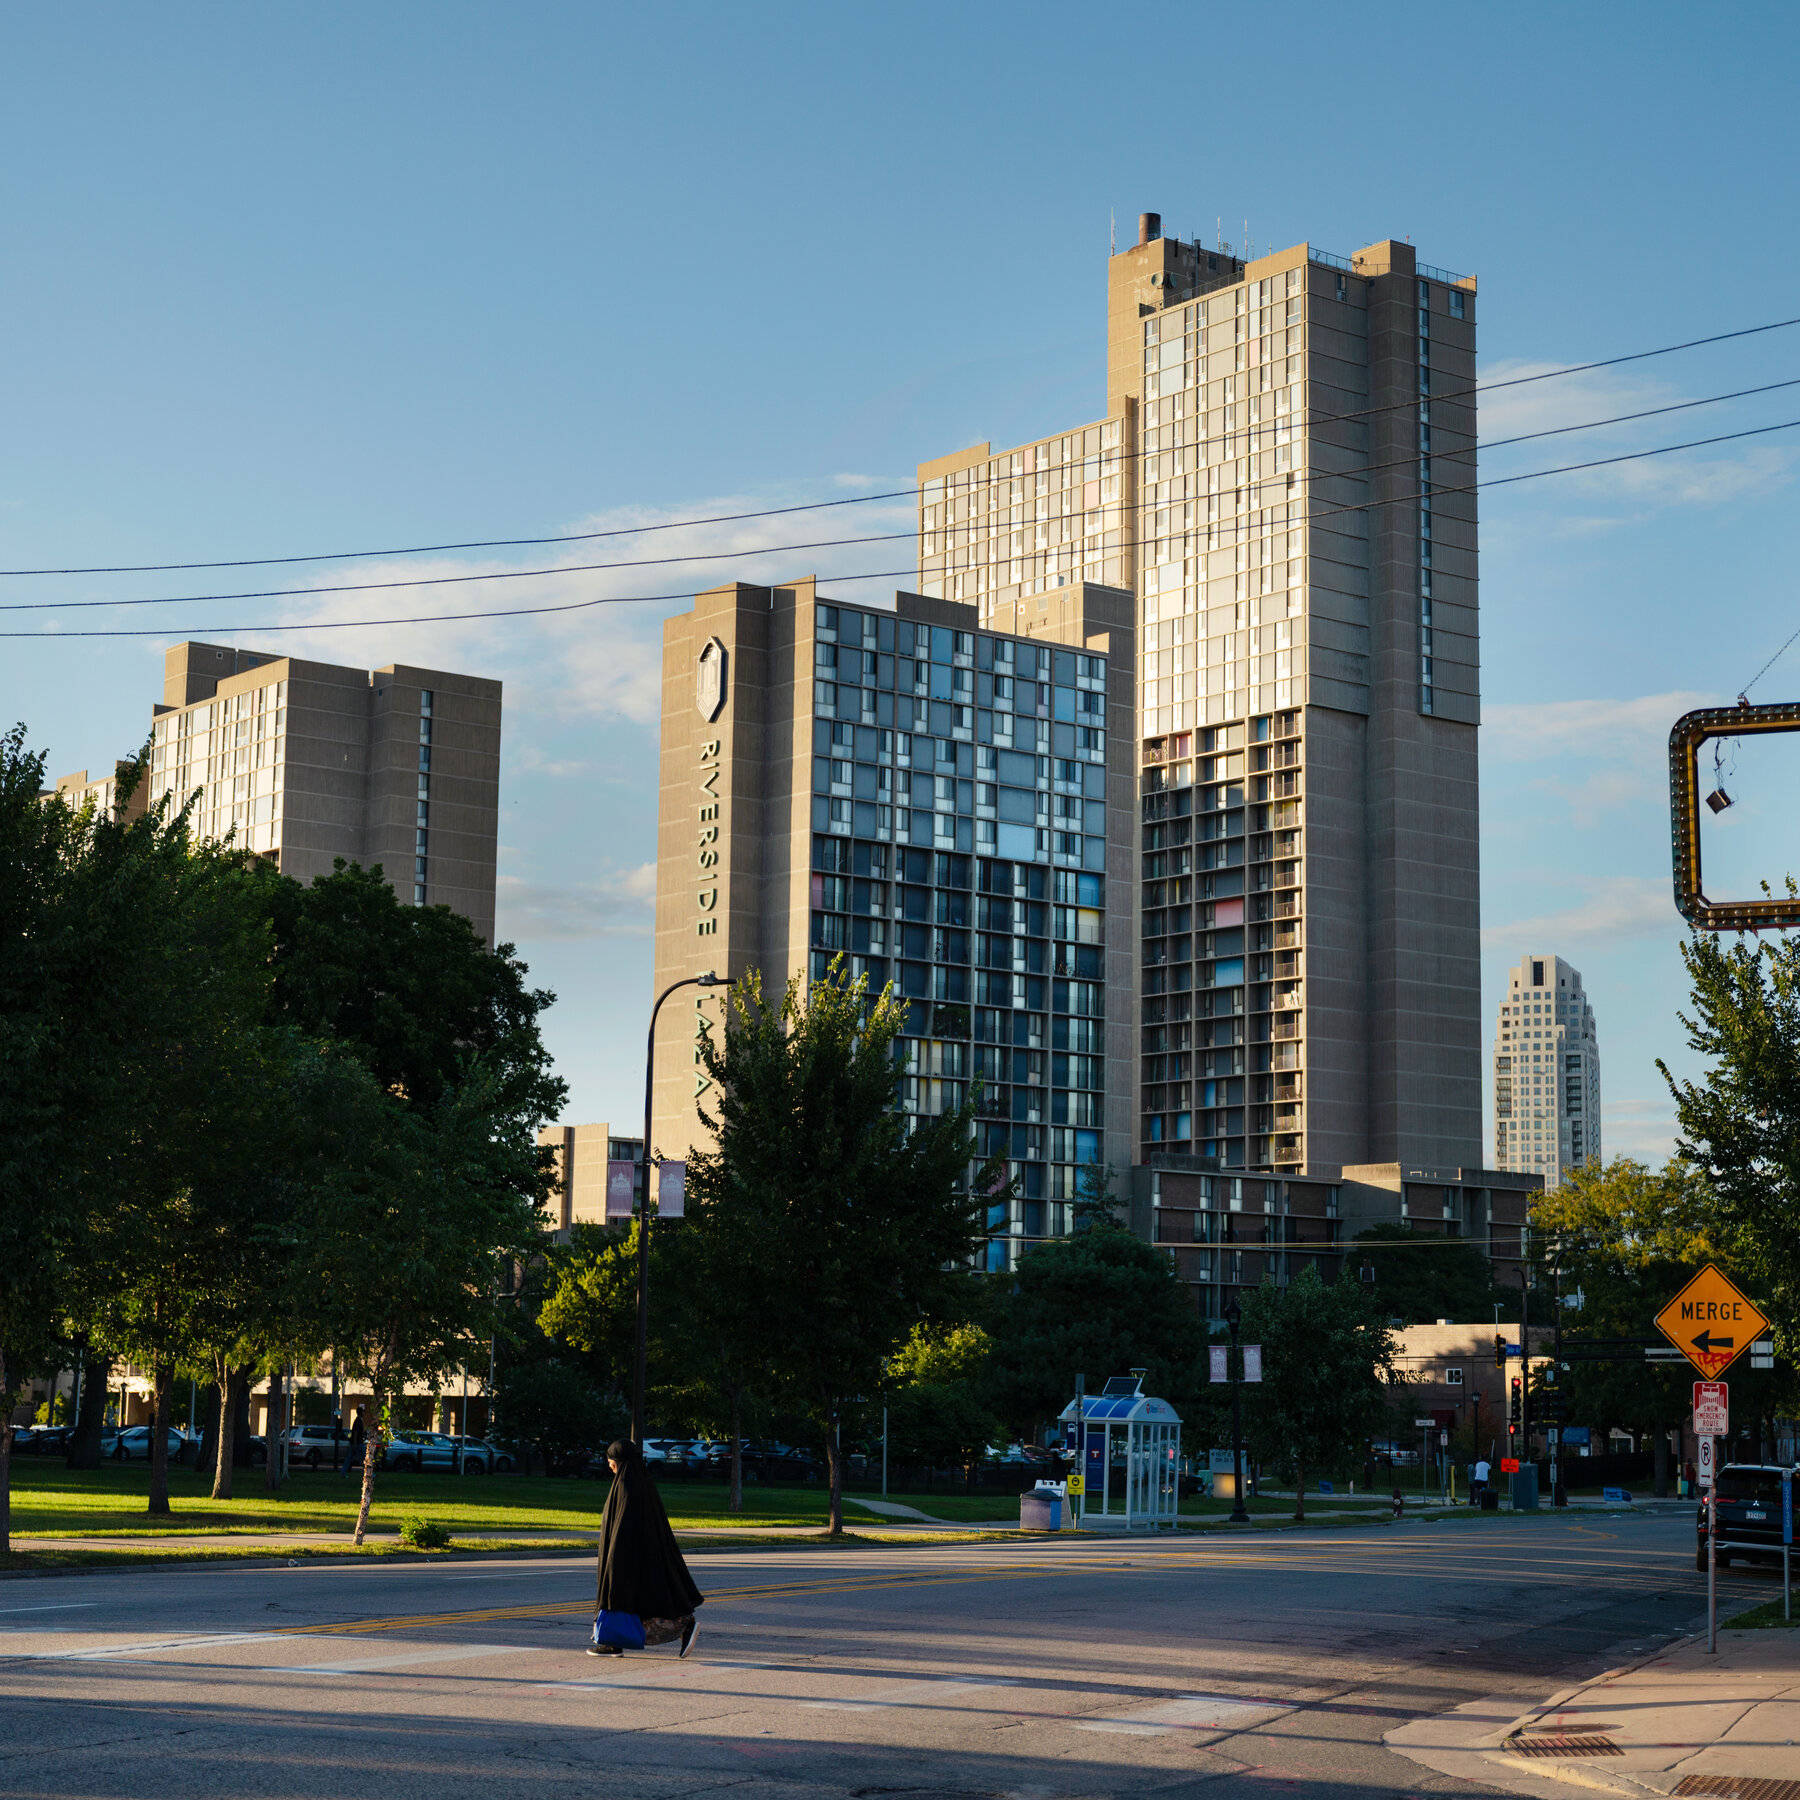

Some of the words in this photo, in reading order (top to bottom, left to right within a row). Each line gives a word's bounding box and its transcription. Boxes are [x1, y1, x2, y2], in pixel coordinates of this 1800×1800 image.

[696, 739, 720, 936] RIVERSIDE
[1681, 1302, 1742, 1320] MERGE
[1697, 1412, 1725, 1420] EMERGENCY
